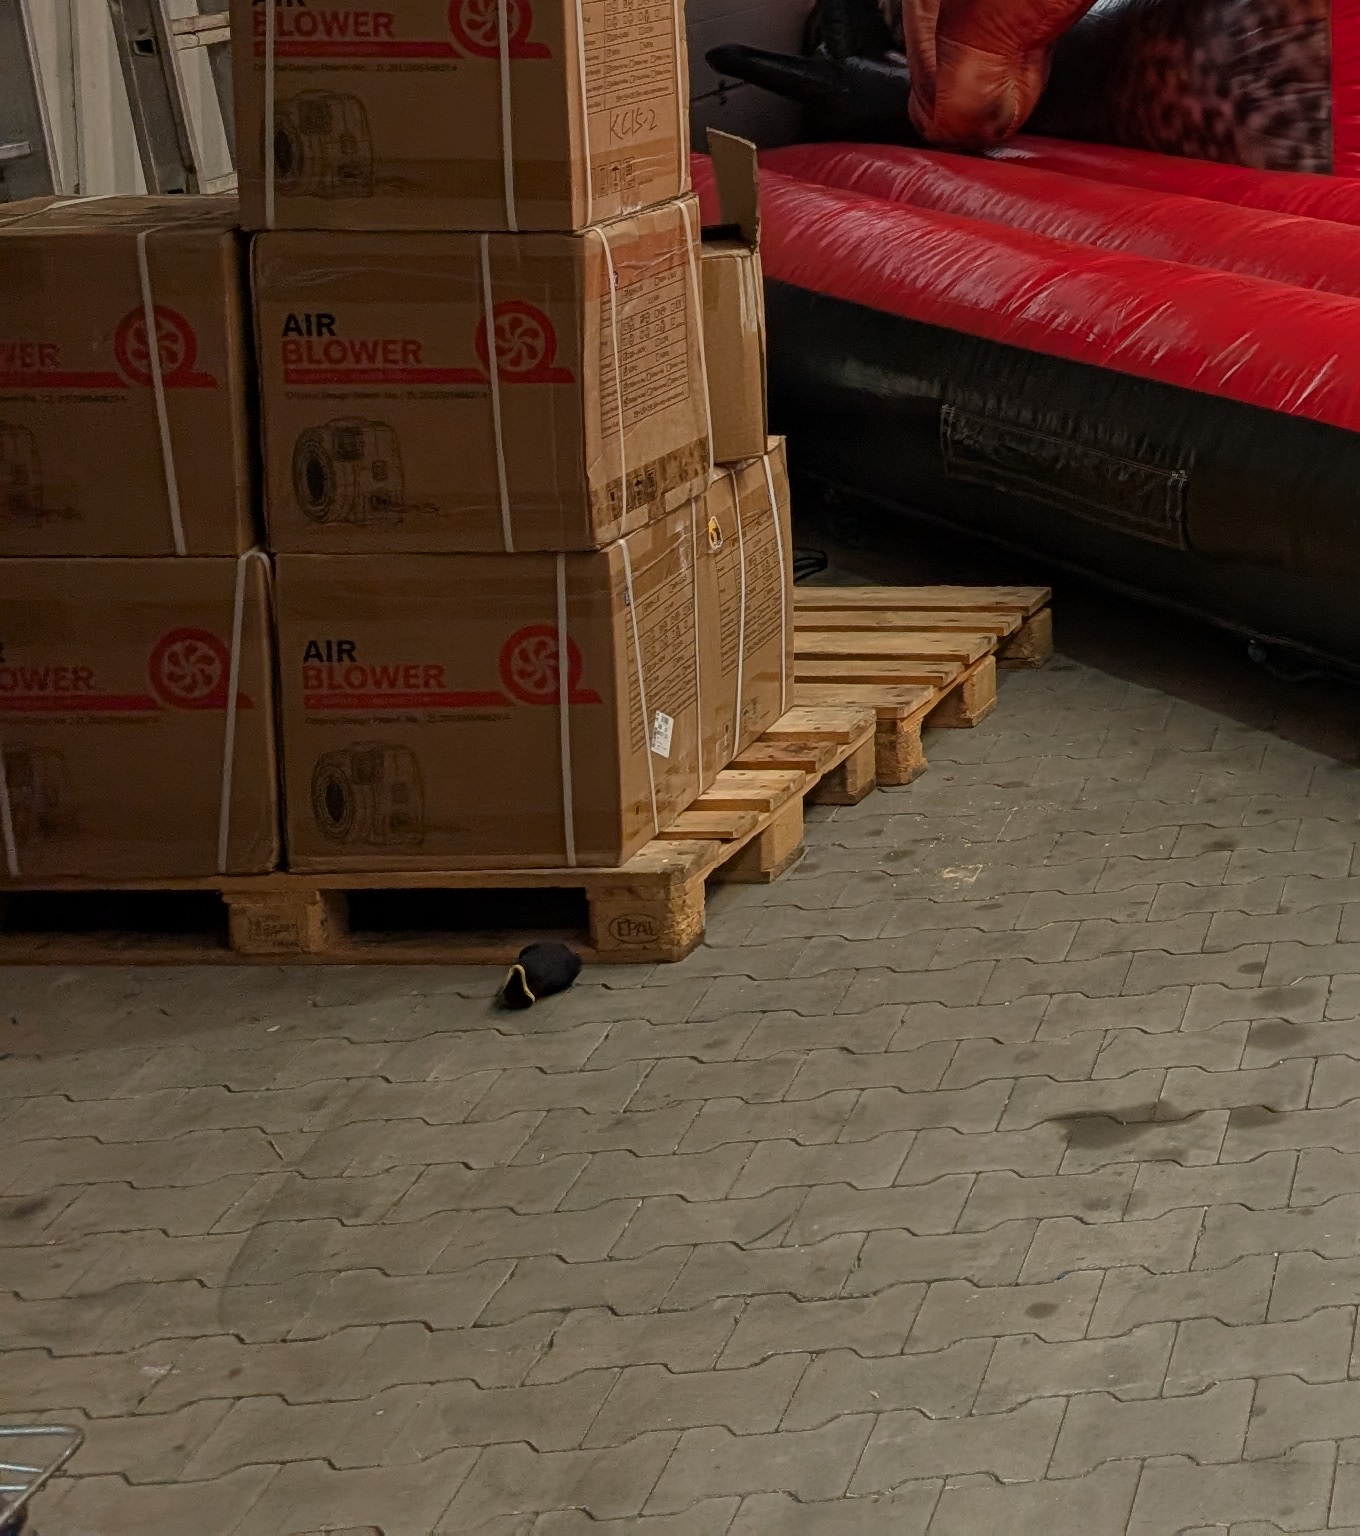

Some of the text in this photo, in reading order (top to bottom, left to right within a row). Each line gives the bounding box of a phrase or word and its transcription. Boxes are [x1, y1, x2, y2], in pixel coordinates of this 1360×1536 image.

[282, 312, 338, 338] AIR
[281, 338, 424, 366] BLOWER
[302, 639, 358, 663] AIR
[302, 664, 447, 690] BLOWER
